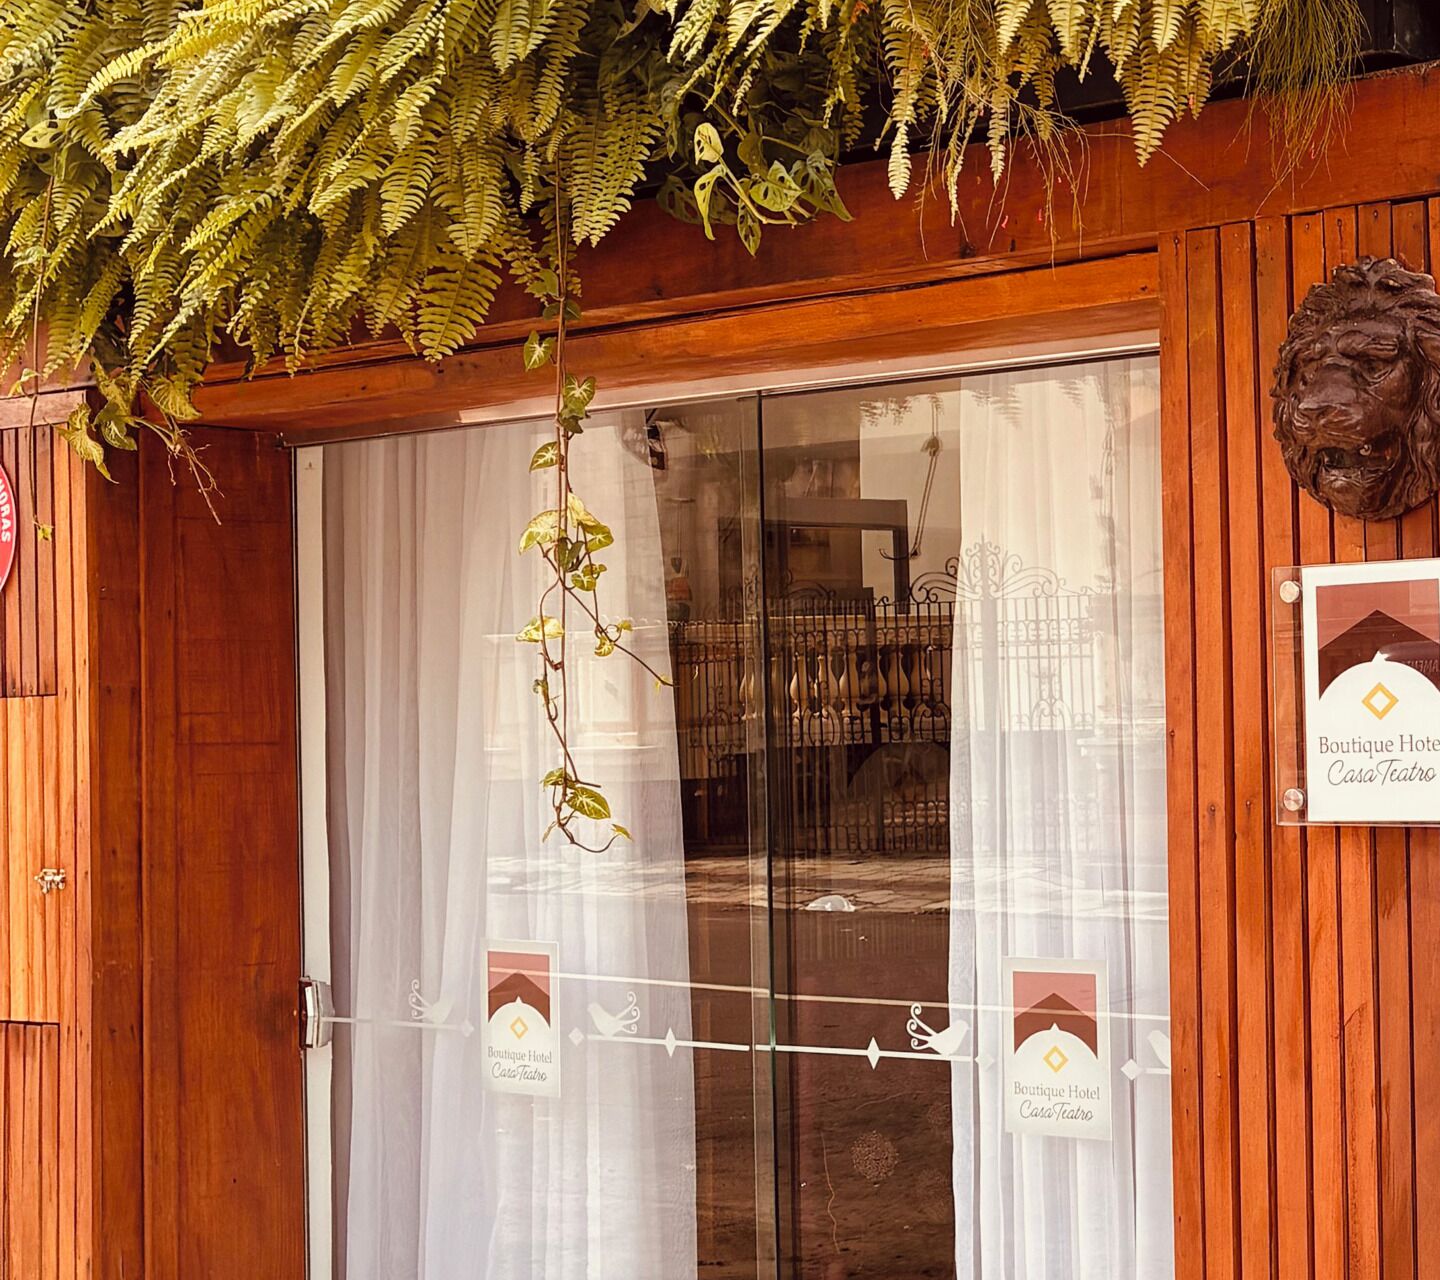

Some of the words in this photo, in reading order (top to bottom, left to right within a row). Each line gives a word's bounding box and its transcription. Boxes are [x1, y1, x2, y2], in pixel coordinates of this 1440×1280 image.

[1318, 735, 1394, 758] Boutique
[1327, 759, 1377, 786] Casa
[1376, 758, 1437, 786] Teatro
[488, 1046, 526, 1064] Boutique
[529, 1050, 552, 1064] Hotel
[492, 1062, 517, 1079] Casa
[516, 1064, 547, 1081] Teatro
[1014, 1081, 1065, 1101] Boutique
[1068, 1085, 1100, 1101] Hotel
[1019, 1099, 1054, 1119] Casa
[1052, 1102, 1094, 1121] Teatro
